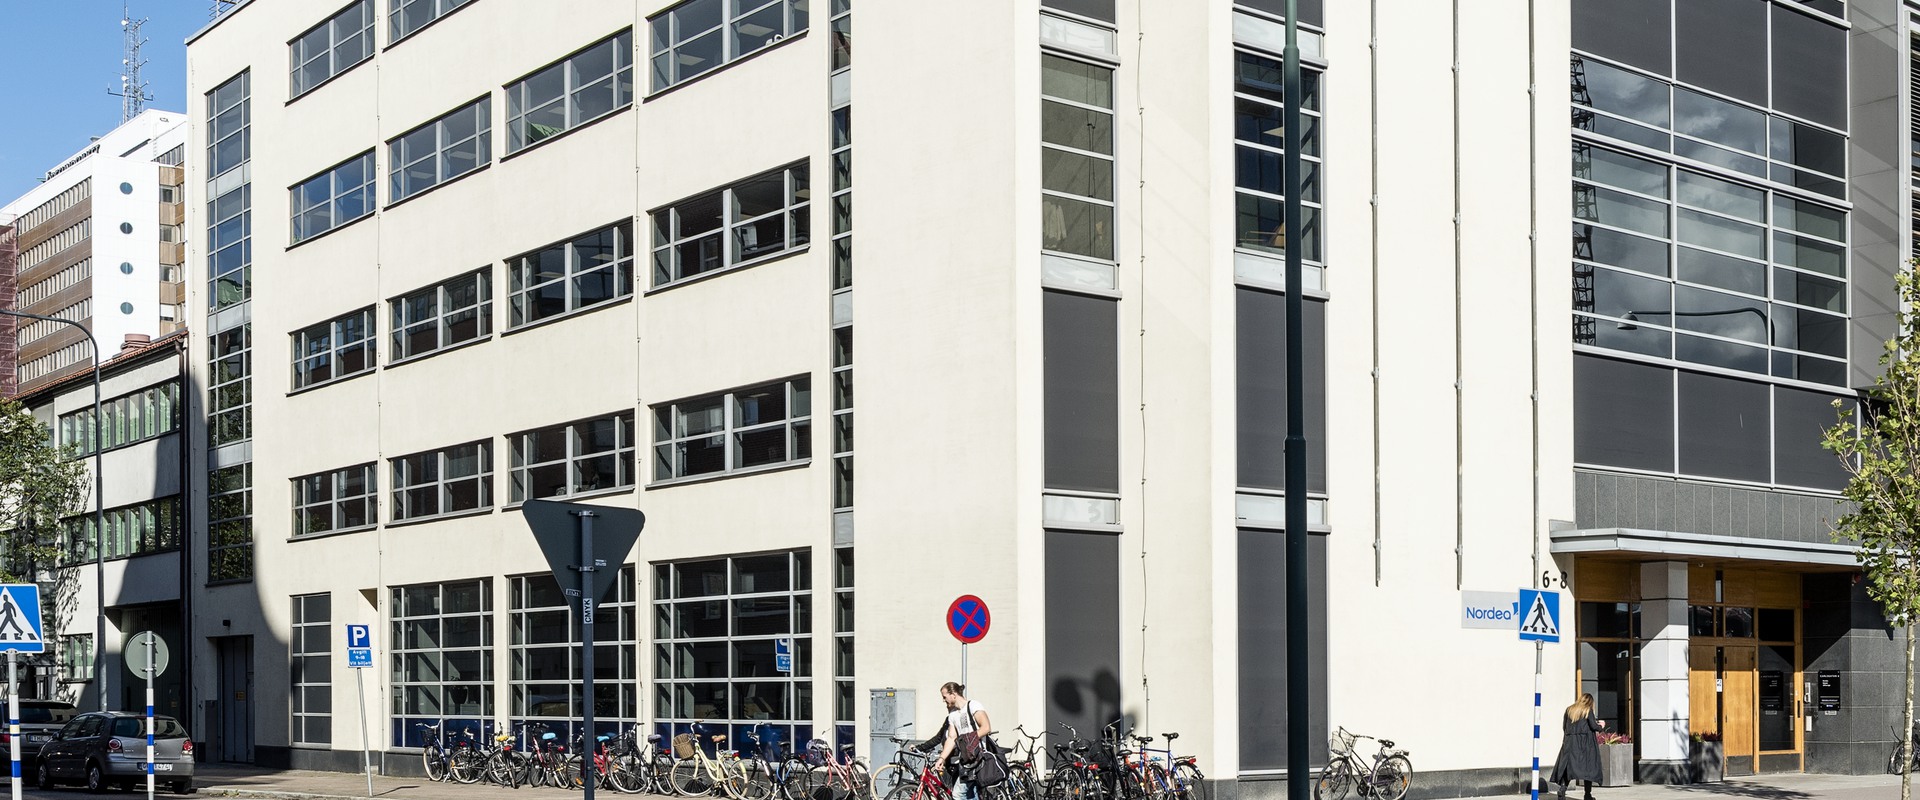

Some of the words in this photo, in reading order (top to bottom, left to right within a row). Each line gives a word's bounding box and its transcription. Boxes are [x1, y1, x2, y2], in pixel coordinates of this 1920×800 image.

[584, 599, 592, 623] CMYK
[1466, 606, 1512, 620] Nordea
[352, 626, 366, 646] P
